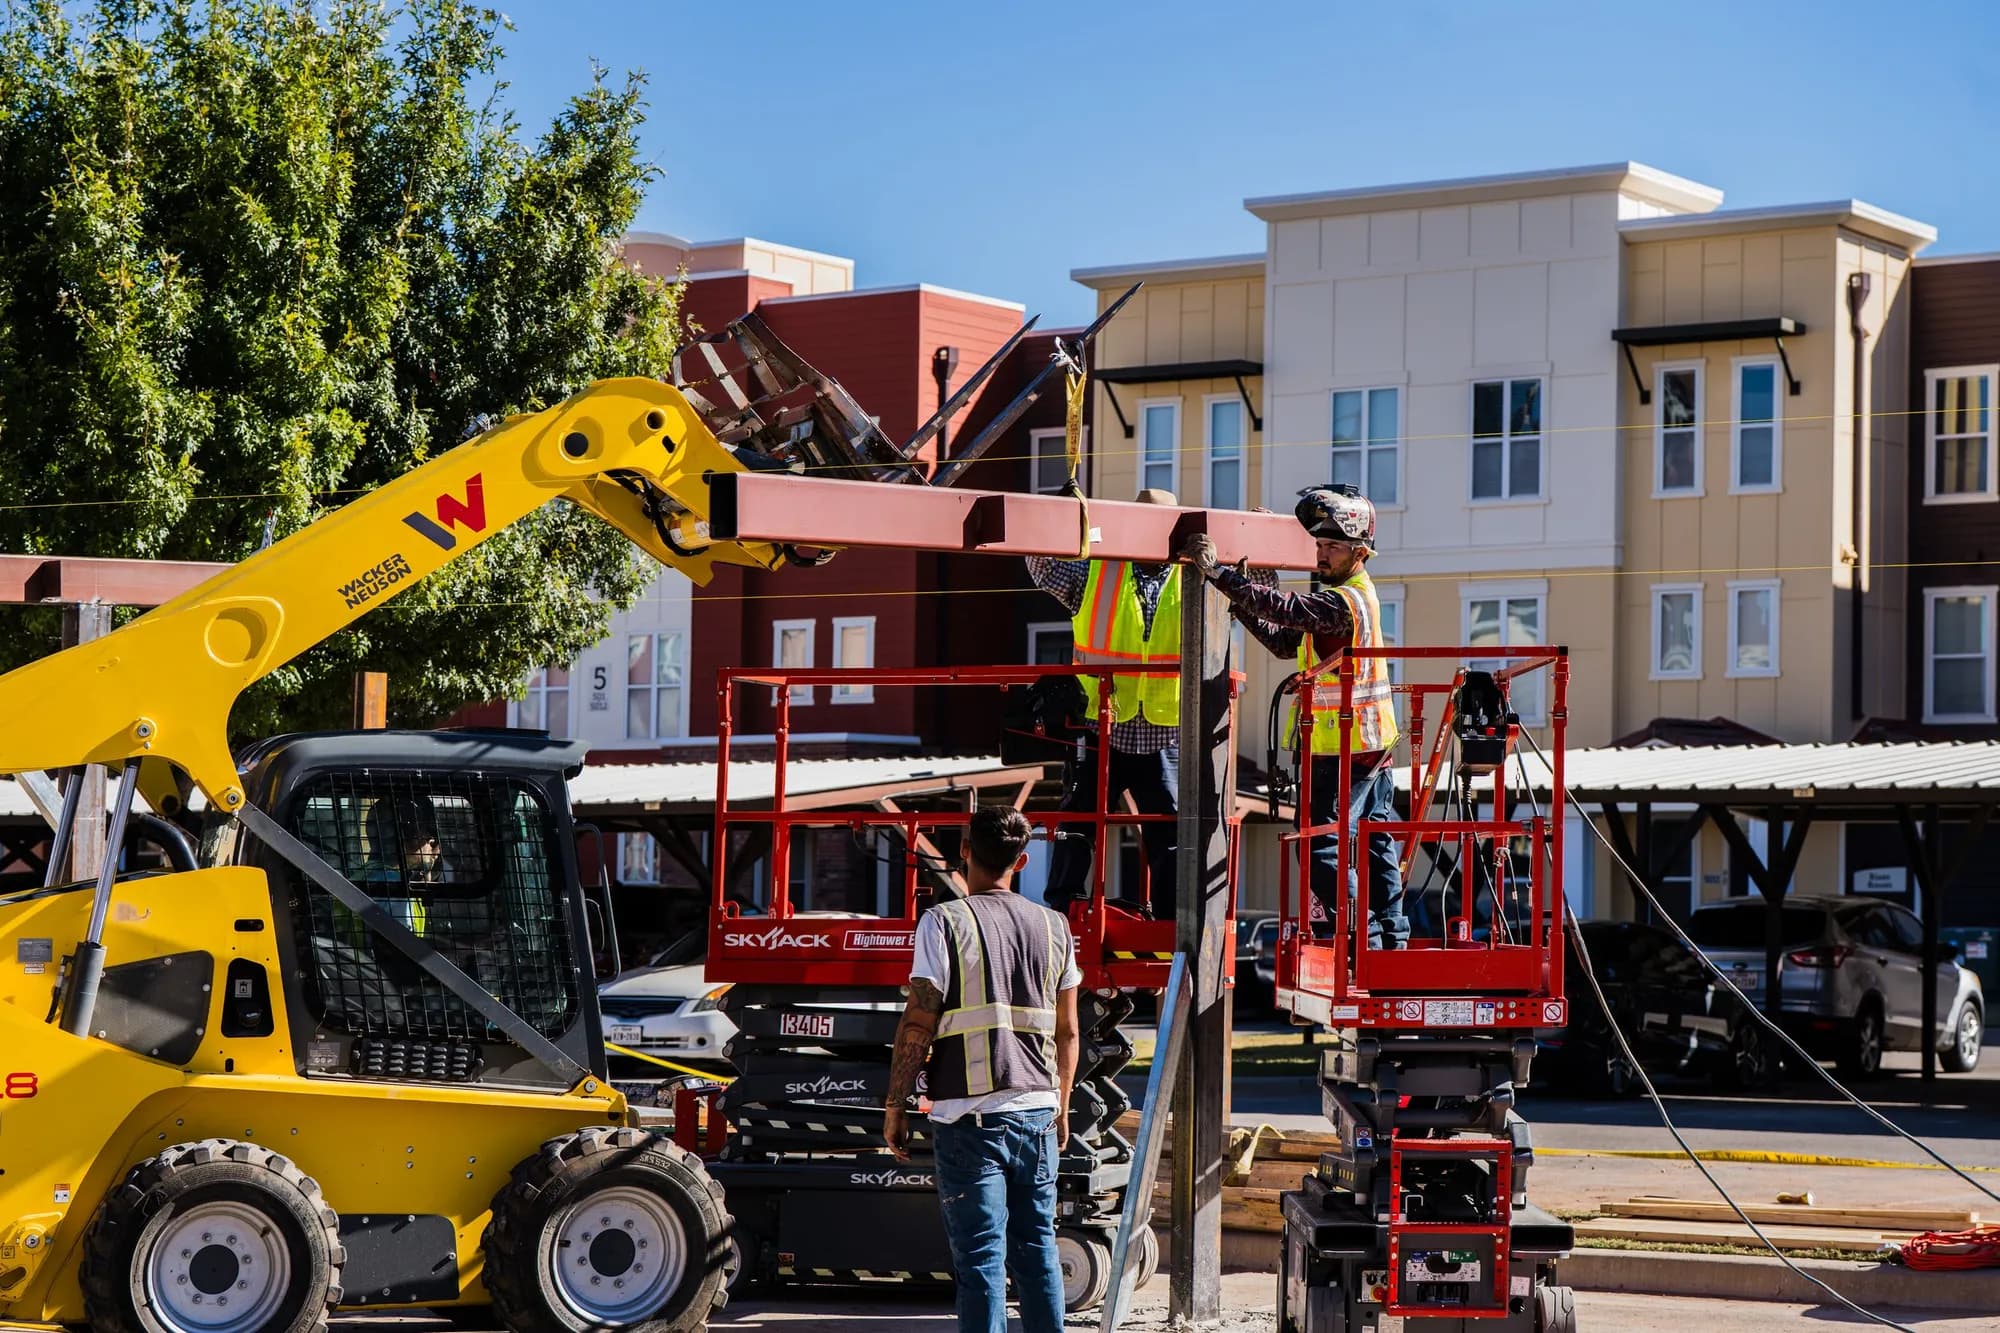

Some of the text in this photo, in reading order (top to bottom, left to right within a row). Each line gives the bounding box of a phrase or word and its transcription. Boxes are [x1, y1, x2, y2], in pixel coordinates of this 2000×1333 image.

[337, 553, 406, 598] WACKER
[345, 563, 412, 610] NEUSON
[593, 666, 606, 690] 5
[724, 926, 831, 950] SKYJACK
[853, 933, 905, 947] Hightower
[783, 1014, 830, 1036] 13405
[0, 1072, 38, 1099] 8
[785, 1075, 867, 1095] SKYJACK
[850, 1169, 934, 1187] SKYJACK
